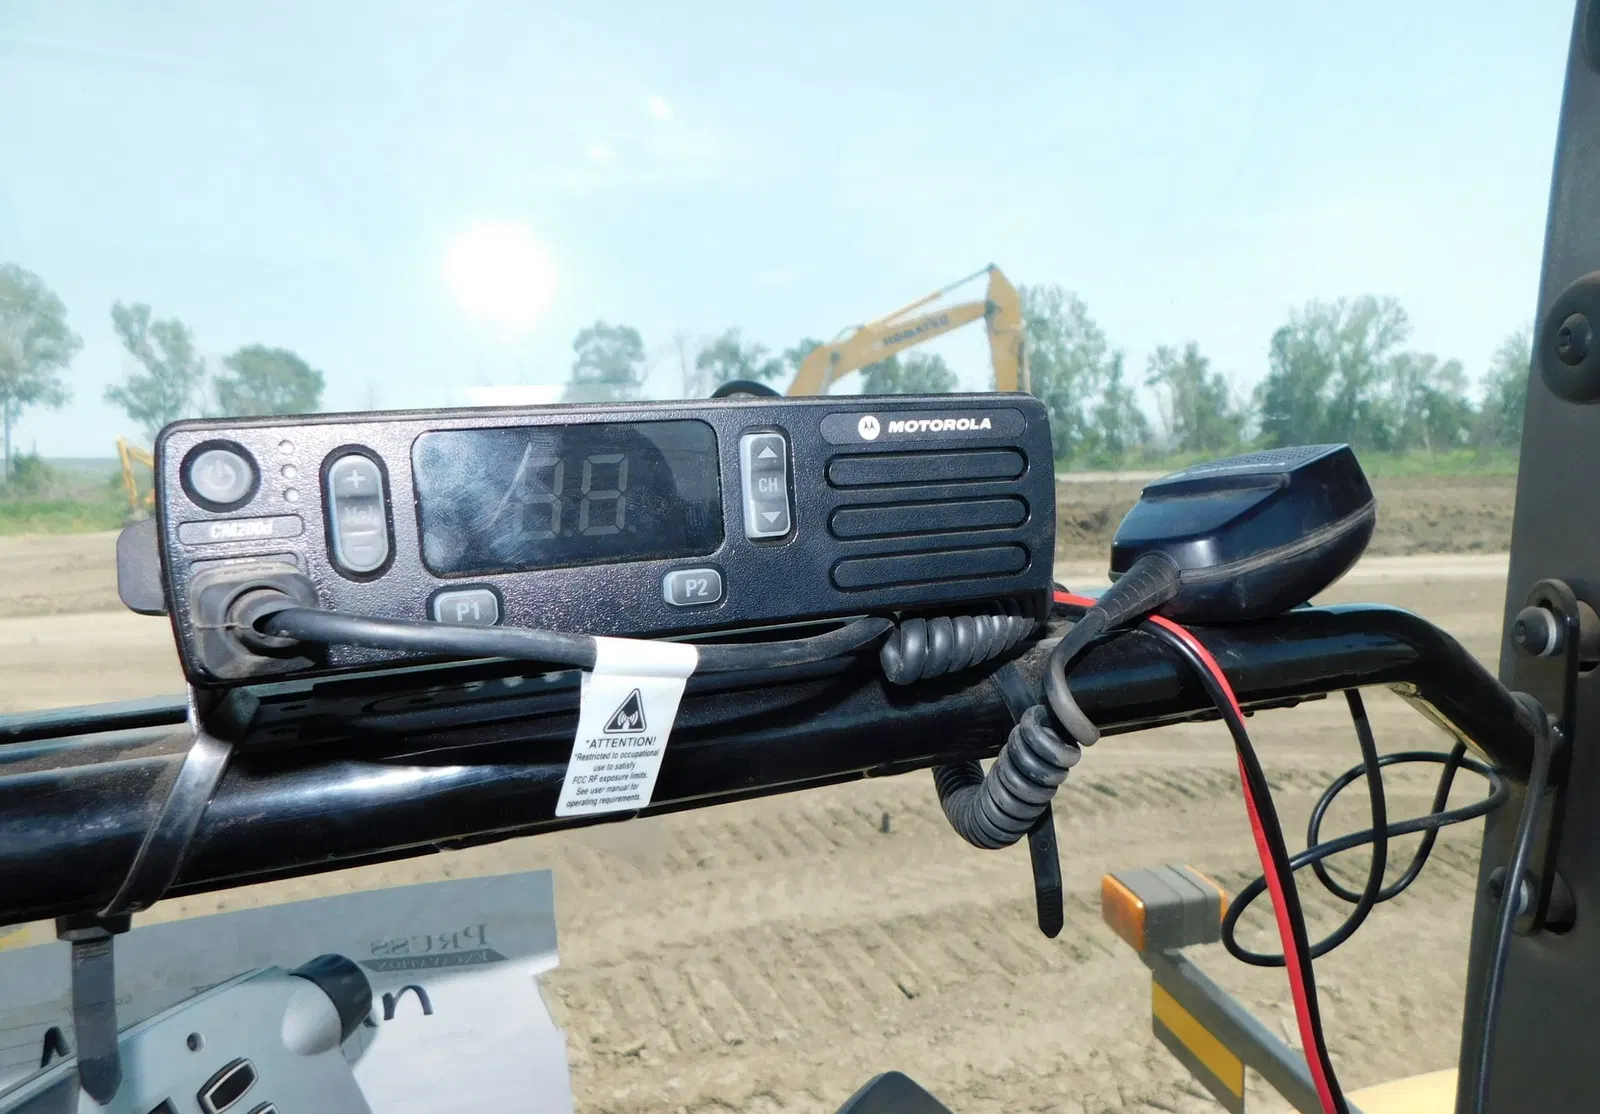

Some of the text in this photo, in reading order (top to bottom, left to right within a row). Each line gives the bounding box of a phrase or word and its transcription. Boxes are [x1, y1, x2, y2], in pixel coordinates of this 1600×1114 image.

[888, 418, 992, 434] MOTOROLA
[758, 477, 778, 493] CH
[684, 578, 709, 598] P2
[456, 601, 480, 622] P1
[612, 752, 619, 760] to
[620, 748, 660, 760] occupational
[607, 763, 614, 771] to
[615, 761, 637, 771] satisfy
[572, 776, 588, 785] FCC
[588, 774, 599, 784] RF
[599, 774, 629, 784] exposure
[576, 783, 640, 796] See user manual for
[566, 798, 598, 808] operating
